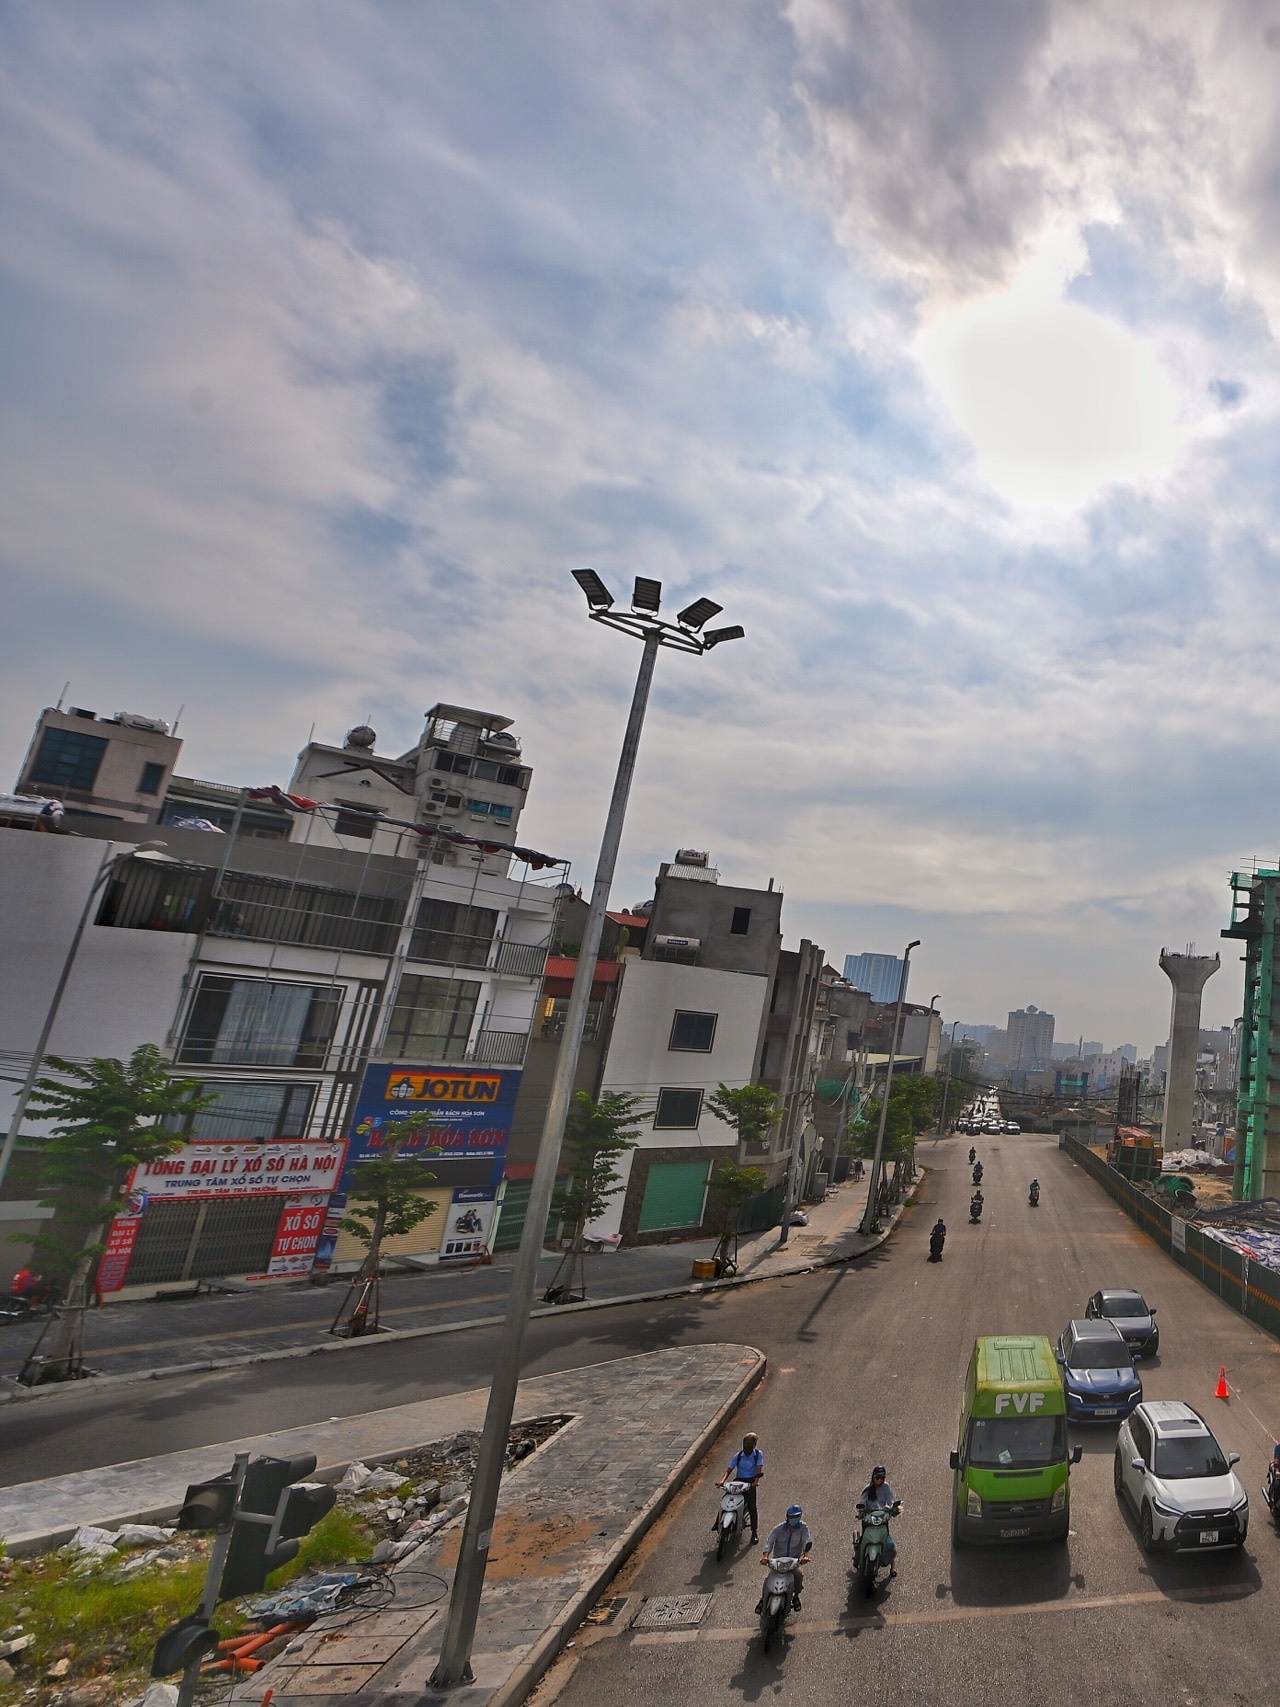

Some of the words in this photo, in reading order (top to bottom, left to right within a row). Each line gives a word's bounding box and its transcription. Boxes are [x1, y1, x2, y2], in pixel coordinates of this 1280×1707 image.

[416, 1078, 497, 1100] JOTUN
[445, 1107, 460, 1116] BÁCH
[468, 1127, 506, 1147] SƠN
[190, 1159, 217, 1177] ĐẠI
[222, 1156, 239, 1174] LÝ
[242, 1152, 265, 1173] XỔ
[266, 1152, 288, 1172] SỐ
[289, 1154, 308, 1171] HÀ
[312, 1154, 337, 1173] NỘI
[165, 1179, 201, 1188] TRUNG
[206, 1177, 228, 1187] TÂM
[230, 1173, 247, 1185] XỔ
[248, 1173, 265, 1184] SỐ
[266, 1175, 280, 1185] TỰ
[281, 1175, 311, 1184] CHỌN
[283, 1209, 304, 1231] XỔ
[303, 1208, 322, 1230] SỐ
[277, 1236, 292, 1254] TỰ
[291, 1235, 319, 1252] CHỌN
[995, 1393, 1046, 1415] FVF
